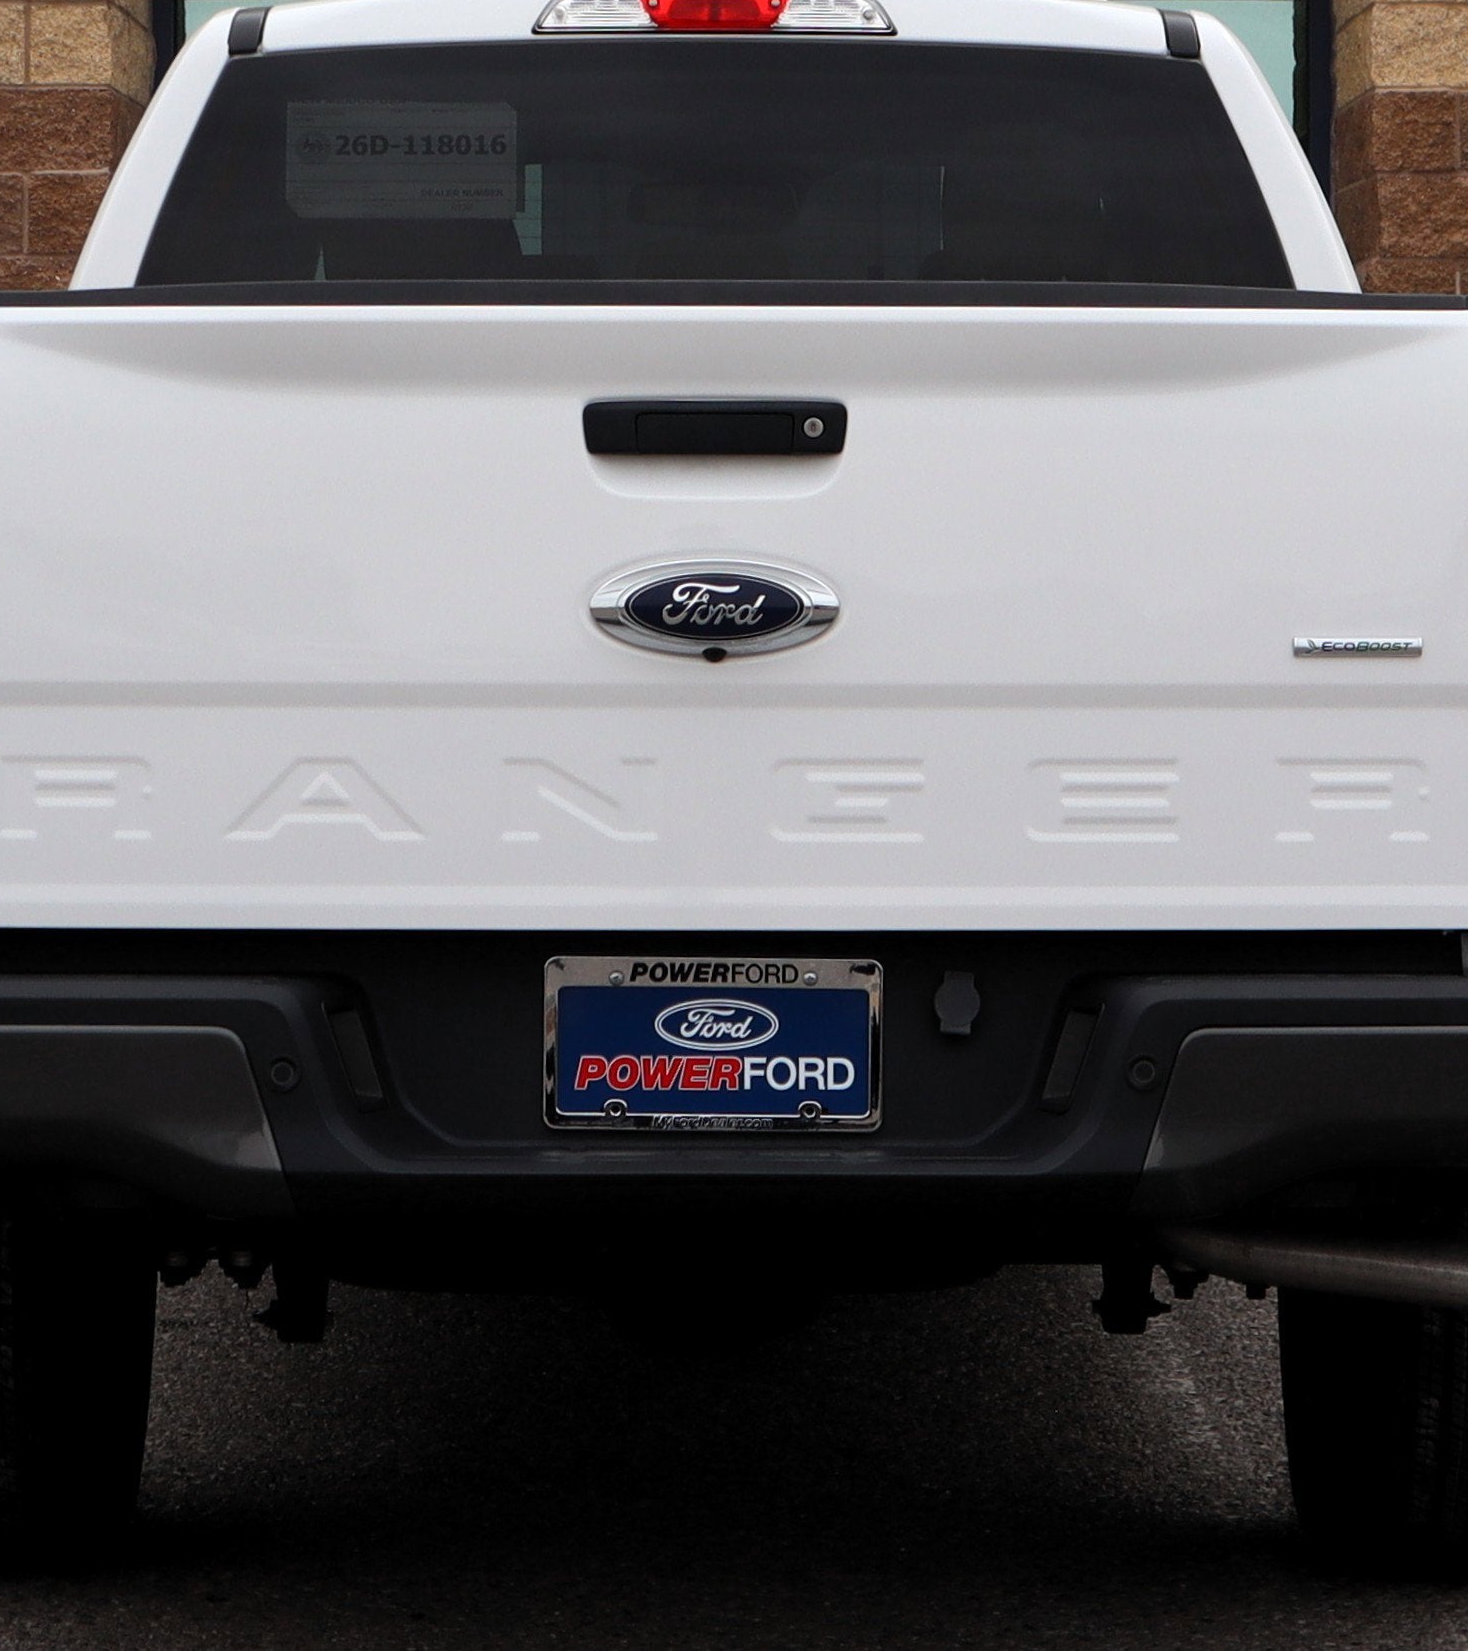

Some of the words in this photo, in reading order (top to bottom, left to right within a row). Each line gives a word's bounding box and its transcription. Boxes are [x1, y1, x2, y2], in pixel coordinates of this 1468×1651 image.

[335, 135, 508, 156] 26D-118016
[420, 188, 460, 197] DEALER
[462, 188, 504, 197] NUMBER
[662, 582, 766, 625] Ford
[629, 961, 800, 984] POWERFORD
[680, 1008, 753, 1039] Ford
[574, 1055, 856, 1091] POWERFORD
